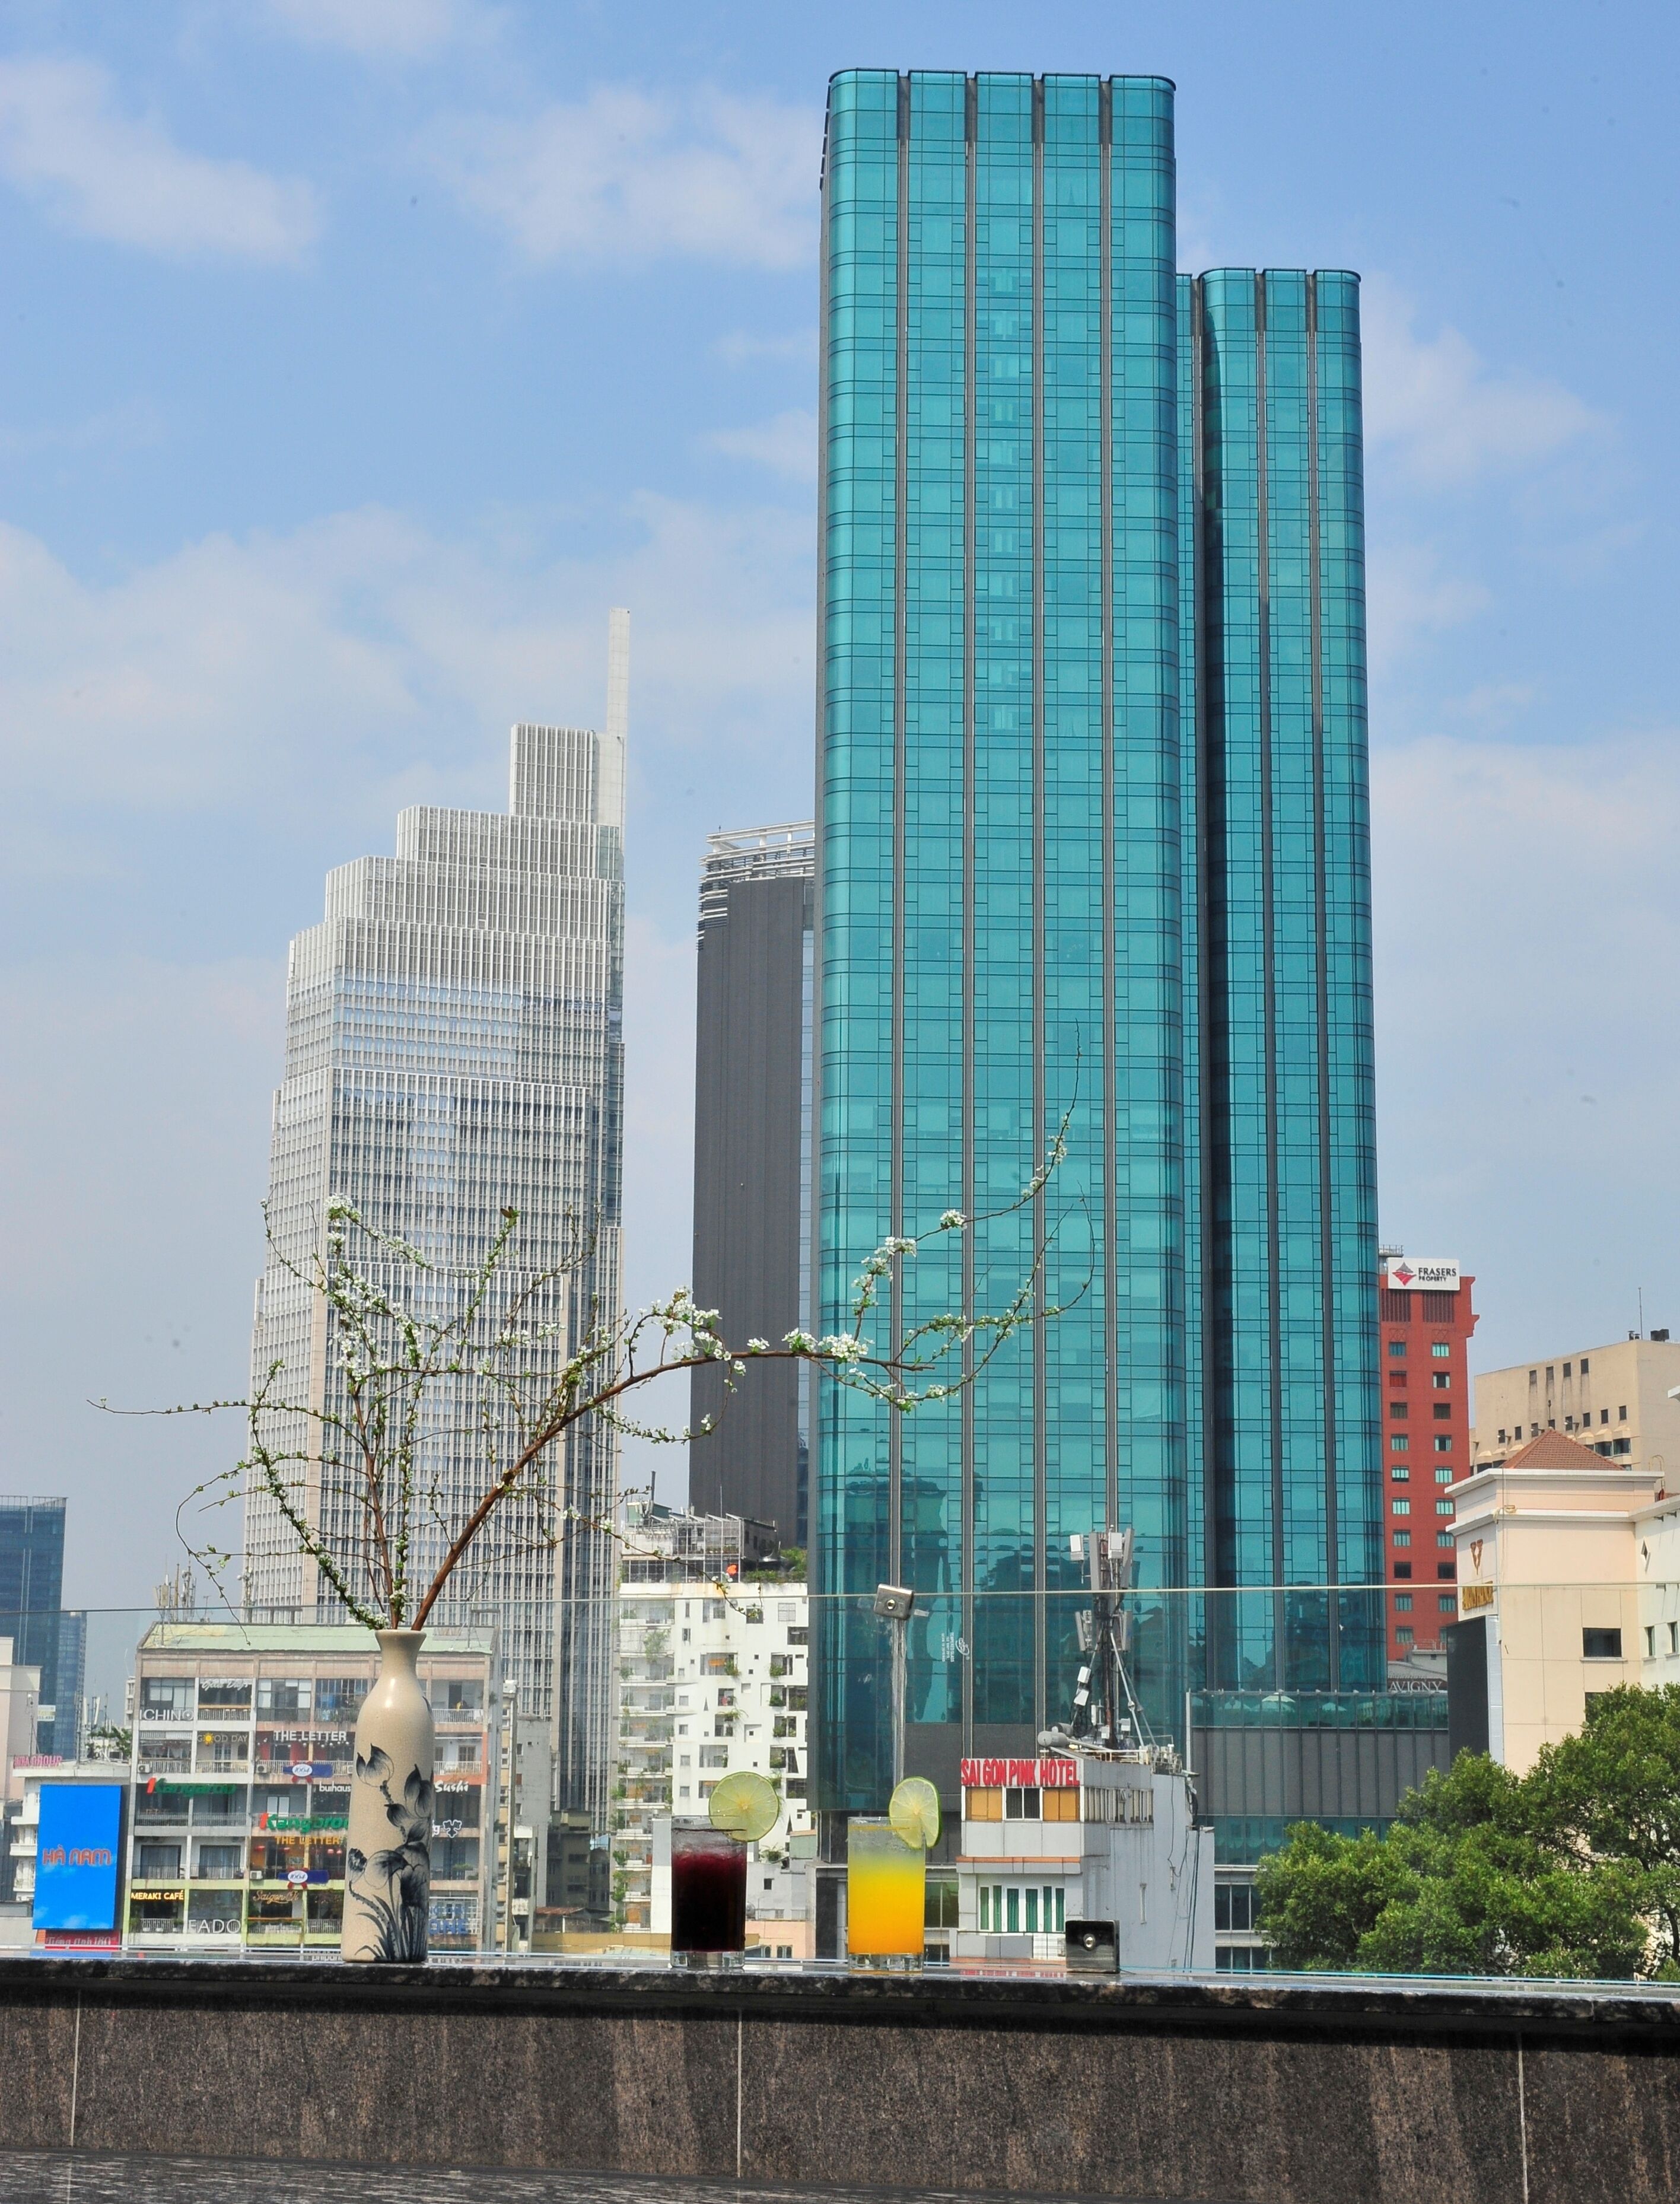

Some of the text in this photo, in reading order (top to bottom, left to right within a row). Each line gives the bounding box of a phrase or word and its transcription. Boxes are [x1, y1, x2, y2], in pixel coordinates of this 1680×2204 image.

[1418, 1267, 1456, 1277] FRASERS
[231, 1734, 248, 1743] DAY
[273, 1731, 347, 1741] THE LETTER
[1008, 1759, 1036, 1786] PINK
[1040, 1759, 1080, 1786] HOTEL
[147, 1777, 238, 1798] Kangaroo
[434, 1780, 469, 1793] Sushi
[274, 1836, 340, 1844] THE LETTER
[131, 1890, 184, 1900] MERAKI CAFÉ
[253, 1890, 285, 1904] Saigon
[189, 1919, 241, 1933] FADO
